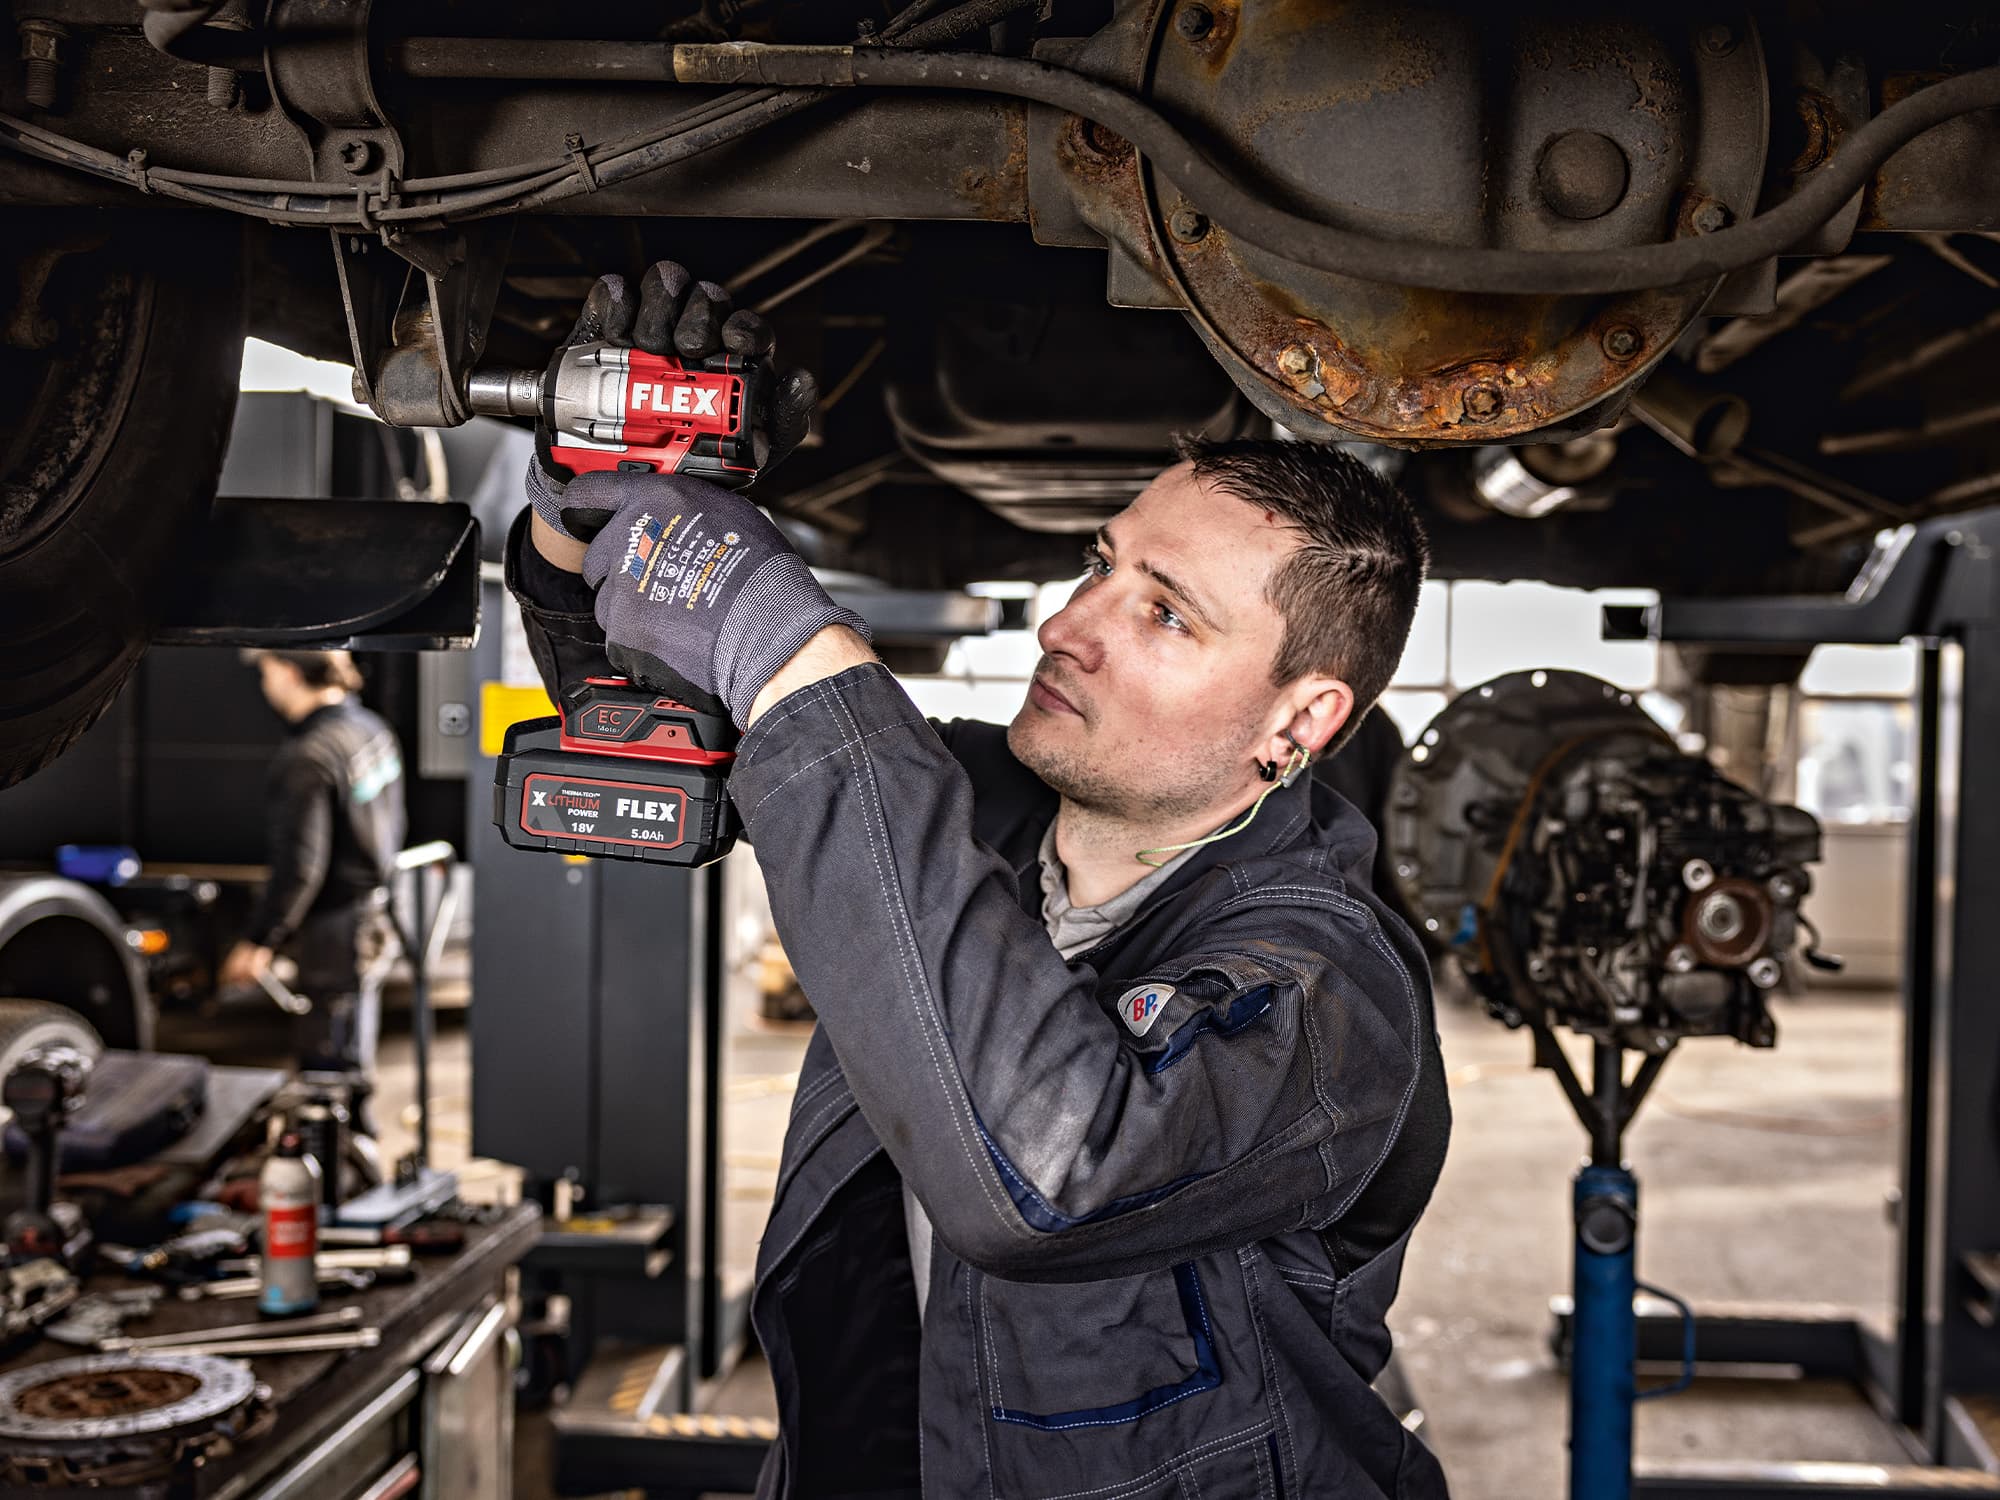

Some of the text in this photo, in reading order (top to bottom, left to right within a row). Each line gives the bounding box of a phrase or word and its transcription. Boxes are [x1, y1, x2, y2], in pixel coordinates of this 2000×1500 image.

[631, 382, 721, 417] FLEX
[619, 513, 654, 575] winkler
[686, 561, 716, 610] STANDARD
[713, 544, 728, 559] 100
[598, 709, 622, 725] EC
[531, 791, 601, 810] X LITHIUM
[616, 798, 678, 822] FLEX
[567, 808, 599, 819] POWER
[571, 822, 595, 834] 18V
[631, 829, 664, 842] 5.0Ah
